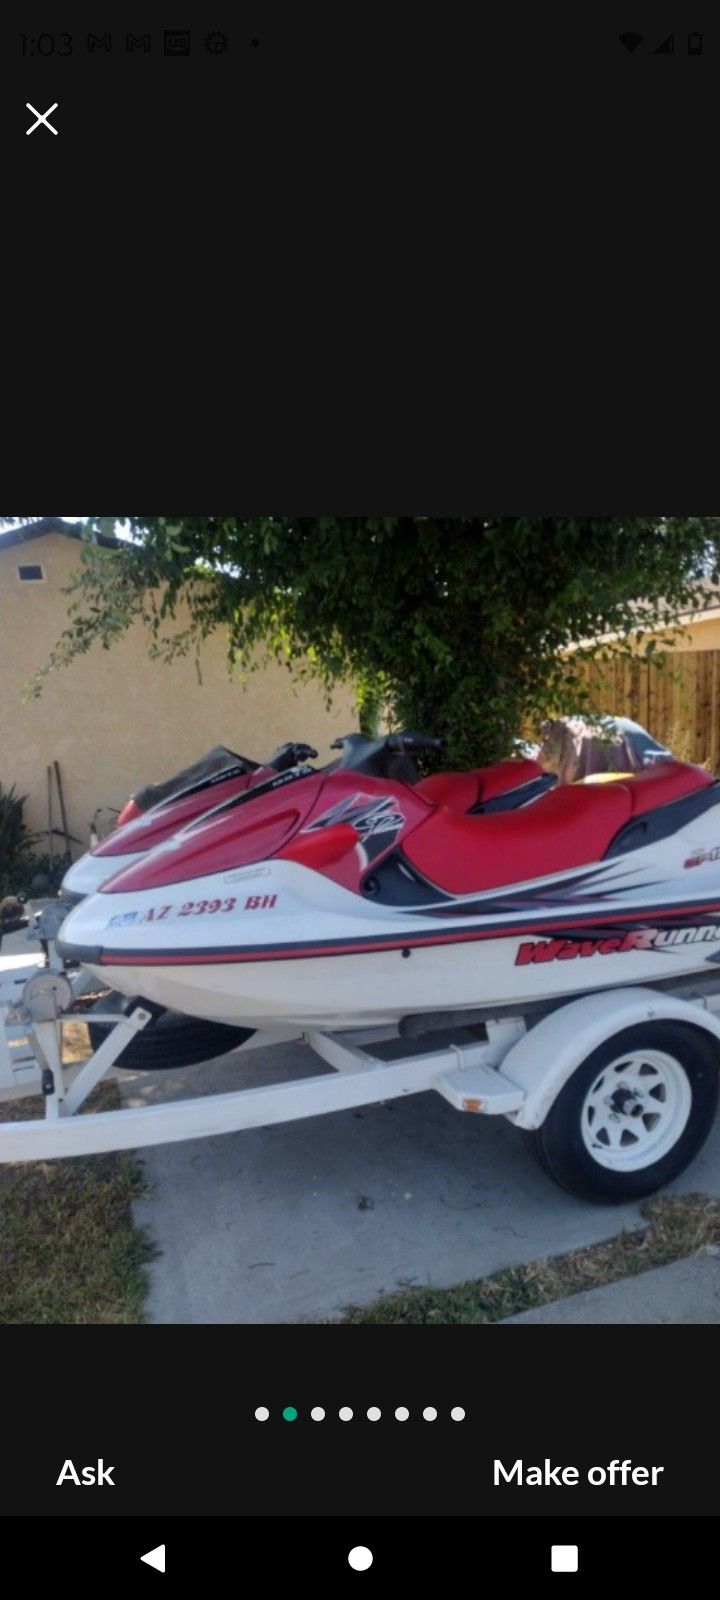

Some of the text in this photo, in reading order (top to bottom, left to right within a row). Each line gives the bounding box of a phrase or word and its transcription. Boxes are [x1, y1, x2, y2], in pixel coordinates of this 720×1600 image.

[140, 905, 172, 924] AZ
[178, 897, 237, 917] 2393
[244, 894, 278, 911] BH
